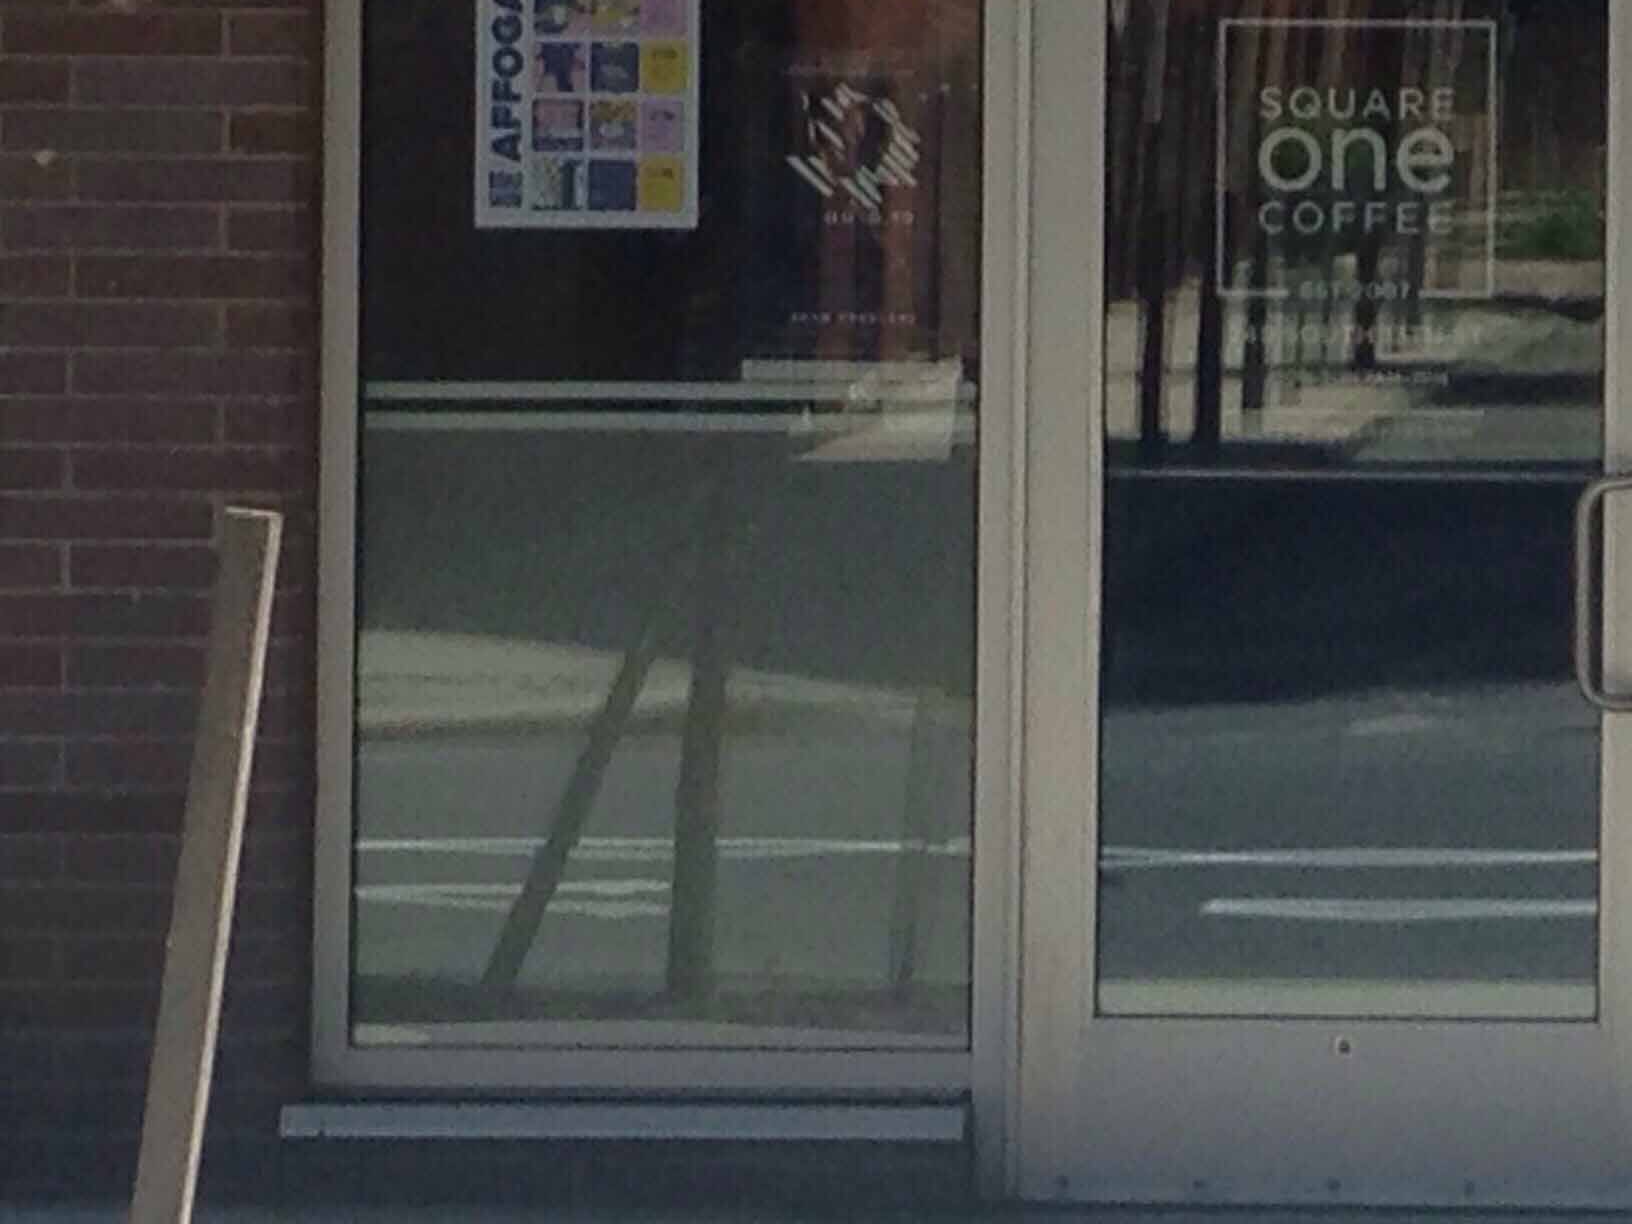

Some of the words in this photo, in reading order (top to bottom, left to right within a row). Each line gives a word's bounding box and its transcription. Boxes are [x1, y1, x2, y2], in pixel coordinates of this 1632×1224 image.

[1259, 87, 1456, 121] SQUARE
[1257, 126, 1455, 192] one
[1258, 200, 1455, 235] COFFEE
